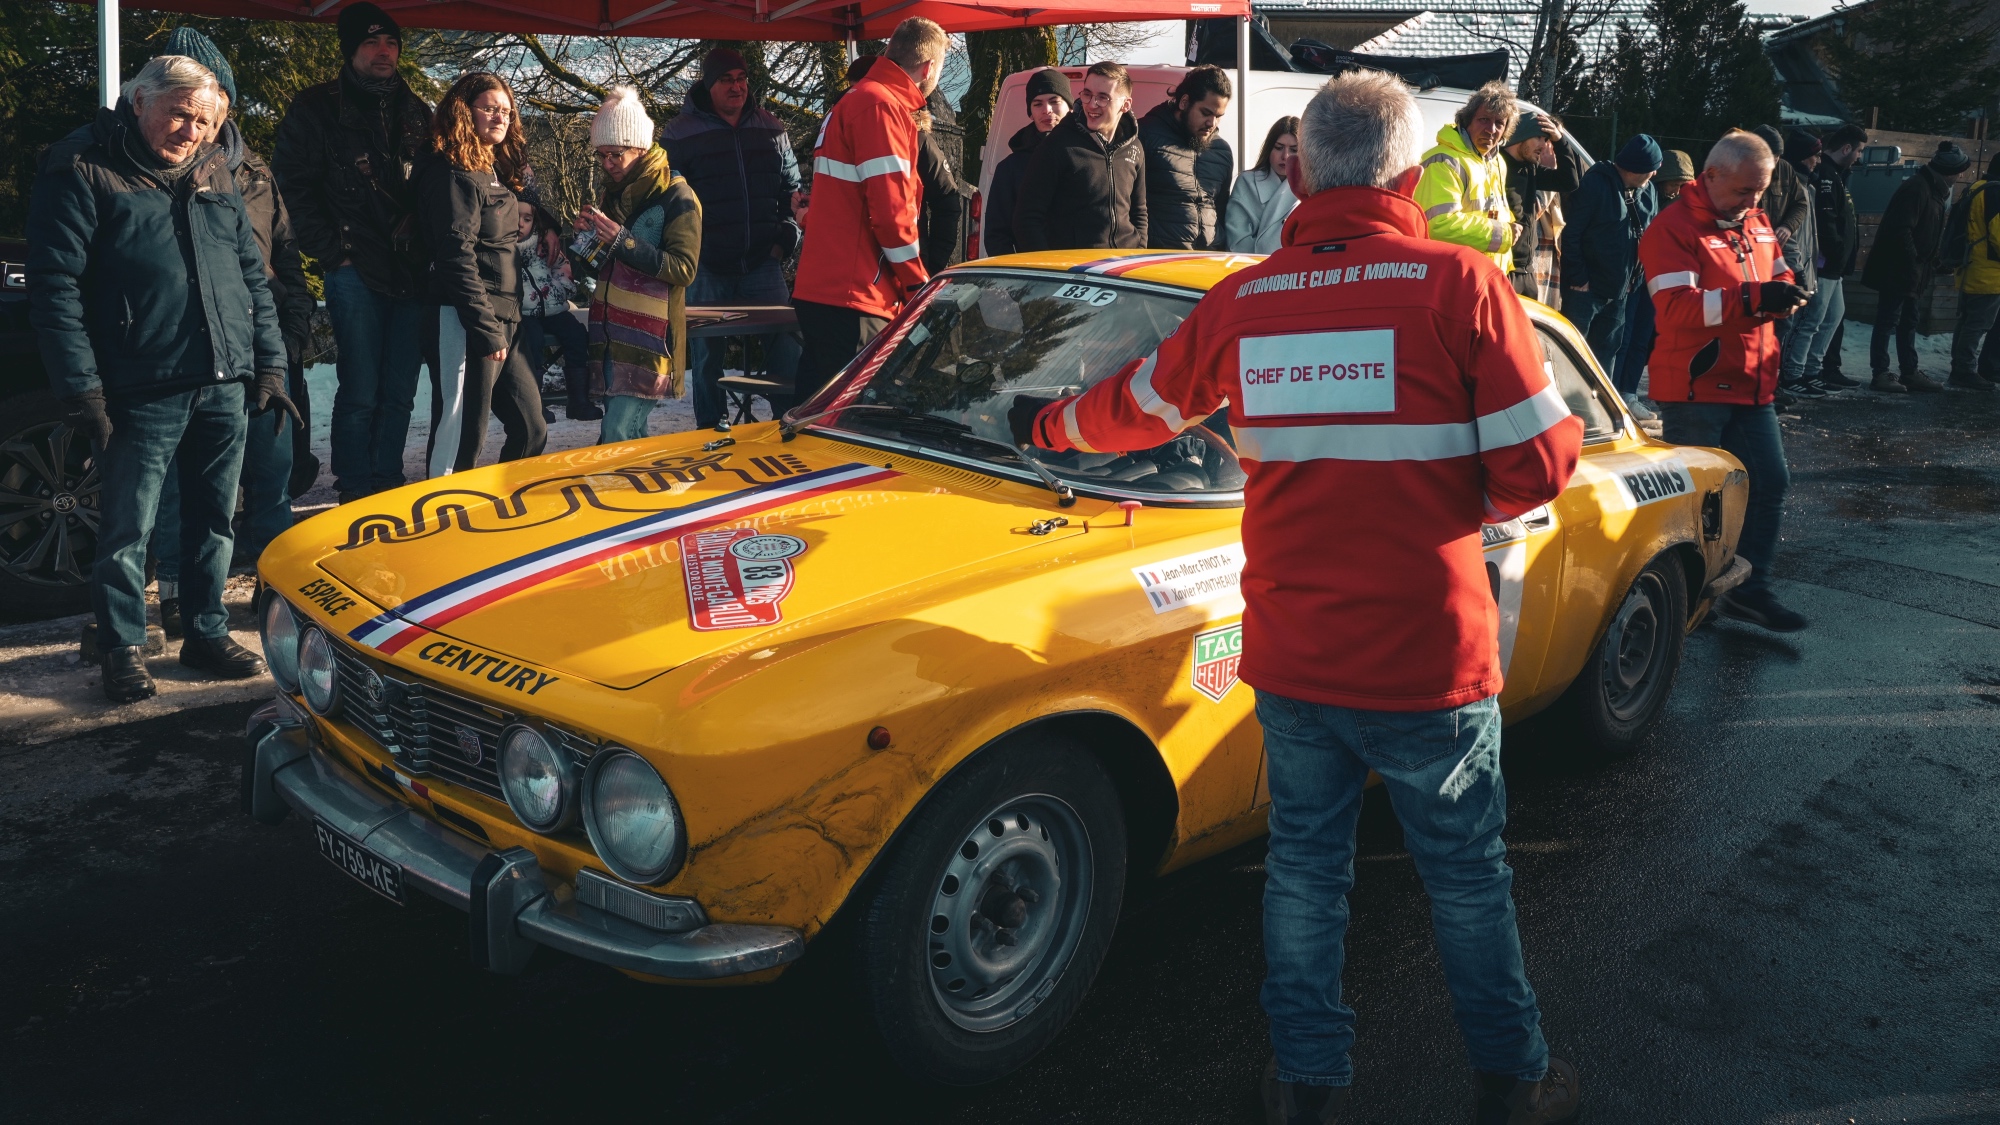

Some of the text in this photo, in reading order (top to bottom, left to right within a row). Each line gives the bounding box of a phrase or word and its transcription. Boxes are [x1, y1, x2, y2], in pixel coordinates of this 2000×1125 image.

[1062, 285, 1091, 299] 83
[1235, 262, 1428, 300] AUTOMOBILE CLUB DE MONACO
[1092, 291, 1114, 304] F
[1245, 362, 1386, 386] CHEF DE POSTE
[1623, 464, 1687, 503] REIMS
[695, 531, 738, 560] RALLYE
[686, 554, 705, 602] HISTORIQUE
[742, 565, 785, 581] 83
[1161, 563, 1201, 582] Jean-Marc
[1198, 555, 1221, 573] FINOT
[297, 578, 357, 617] ESPACE
[700, 560, 758, 625] MONTE-CARLO
[1171, 572, 1240, 602] Xavier PONTHEAUX
[1200, 631, 1242, 660] TAG
[418, 641, 561, 696] CENTURY
[316, 824, 397, 897] FY-759-KE
